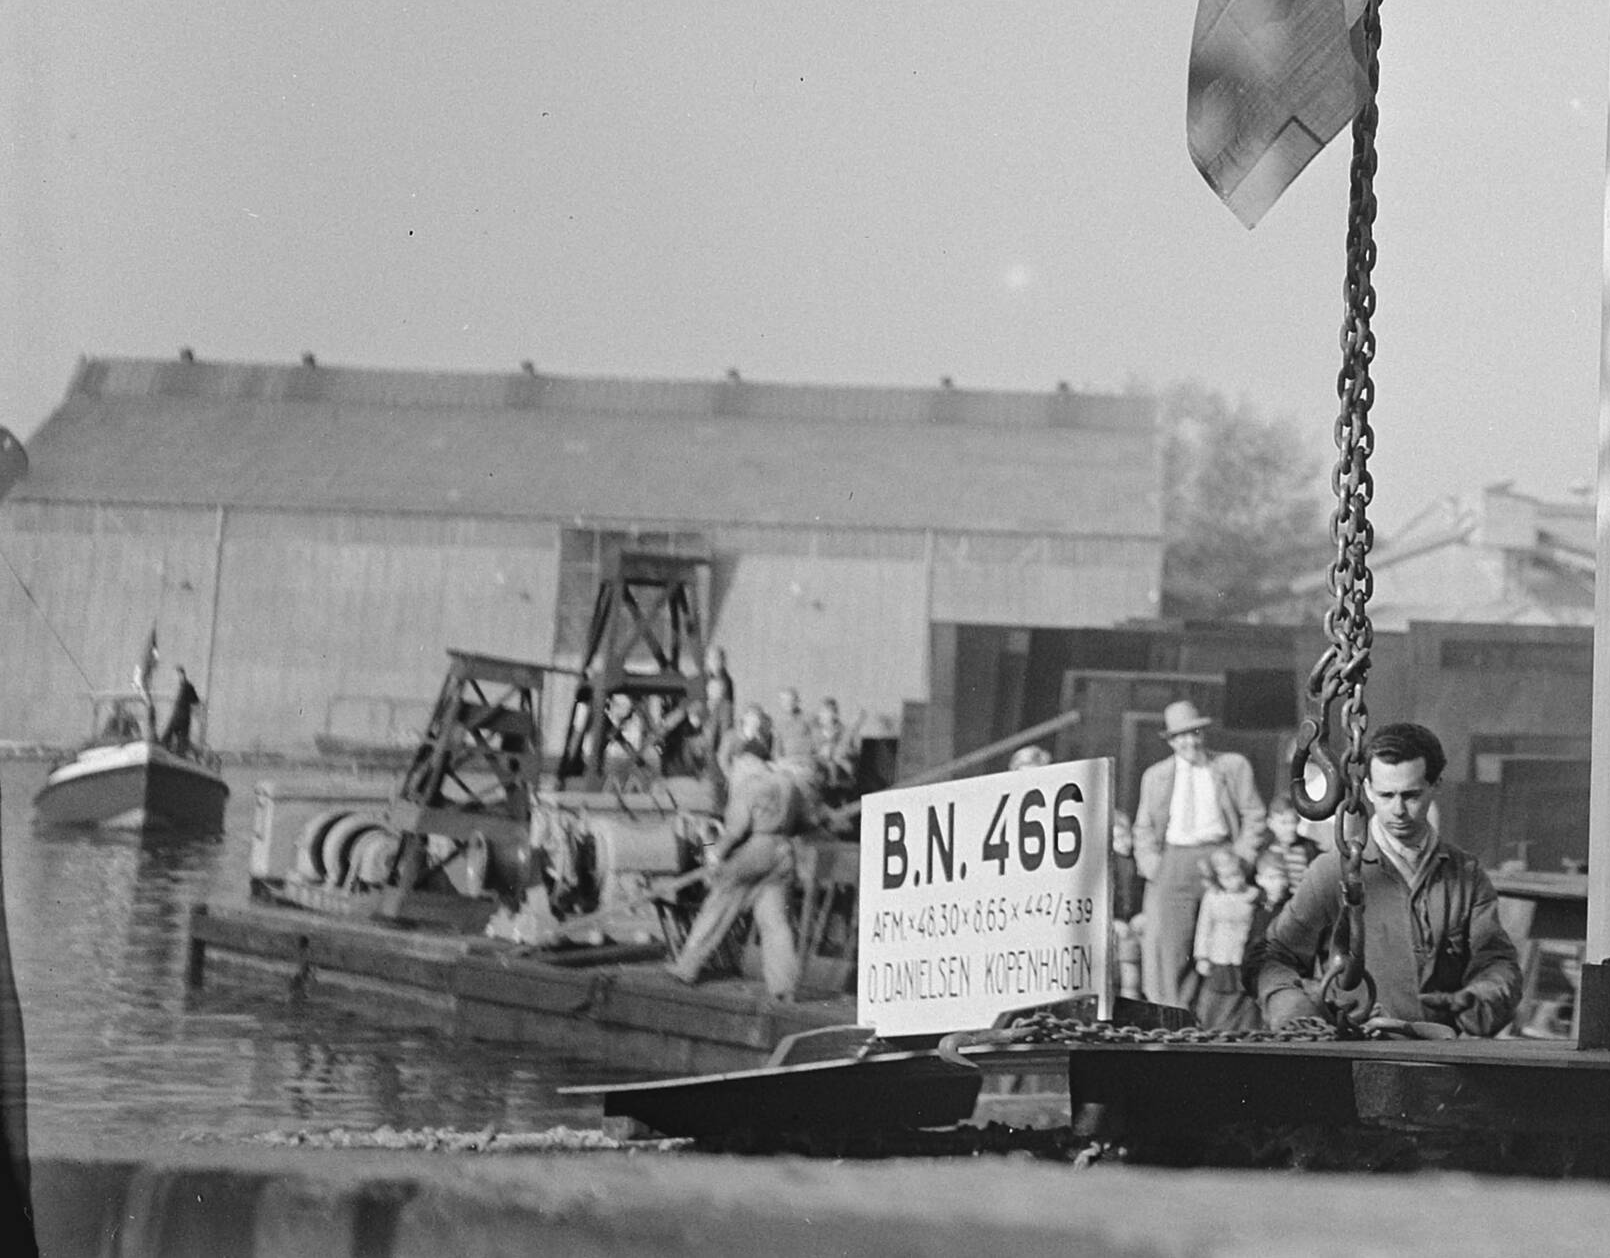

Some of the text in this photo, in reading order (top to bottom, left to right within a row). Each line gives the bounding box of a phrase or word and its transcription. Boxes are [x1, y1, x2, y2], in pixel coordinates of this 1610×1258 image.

[883, 782, 1084, 890] B.N. 466
[985, 944, 1091, 995] KOPENHAGEN
